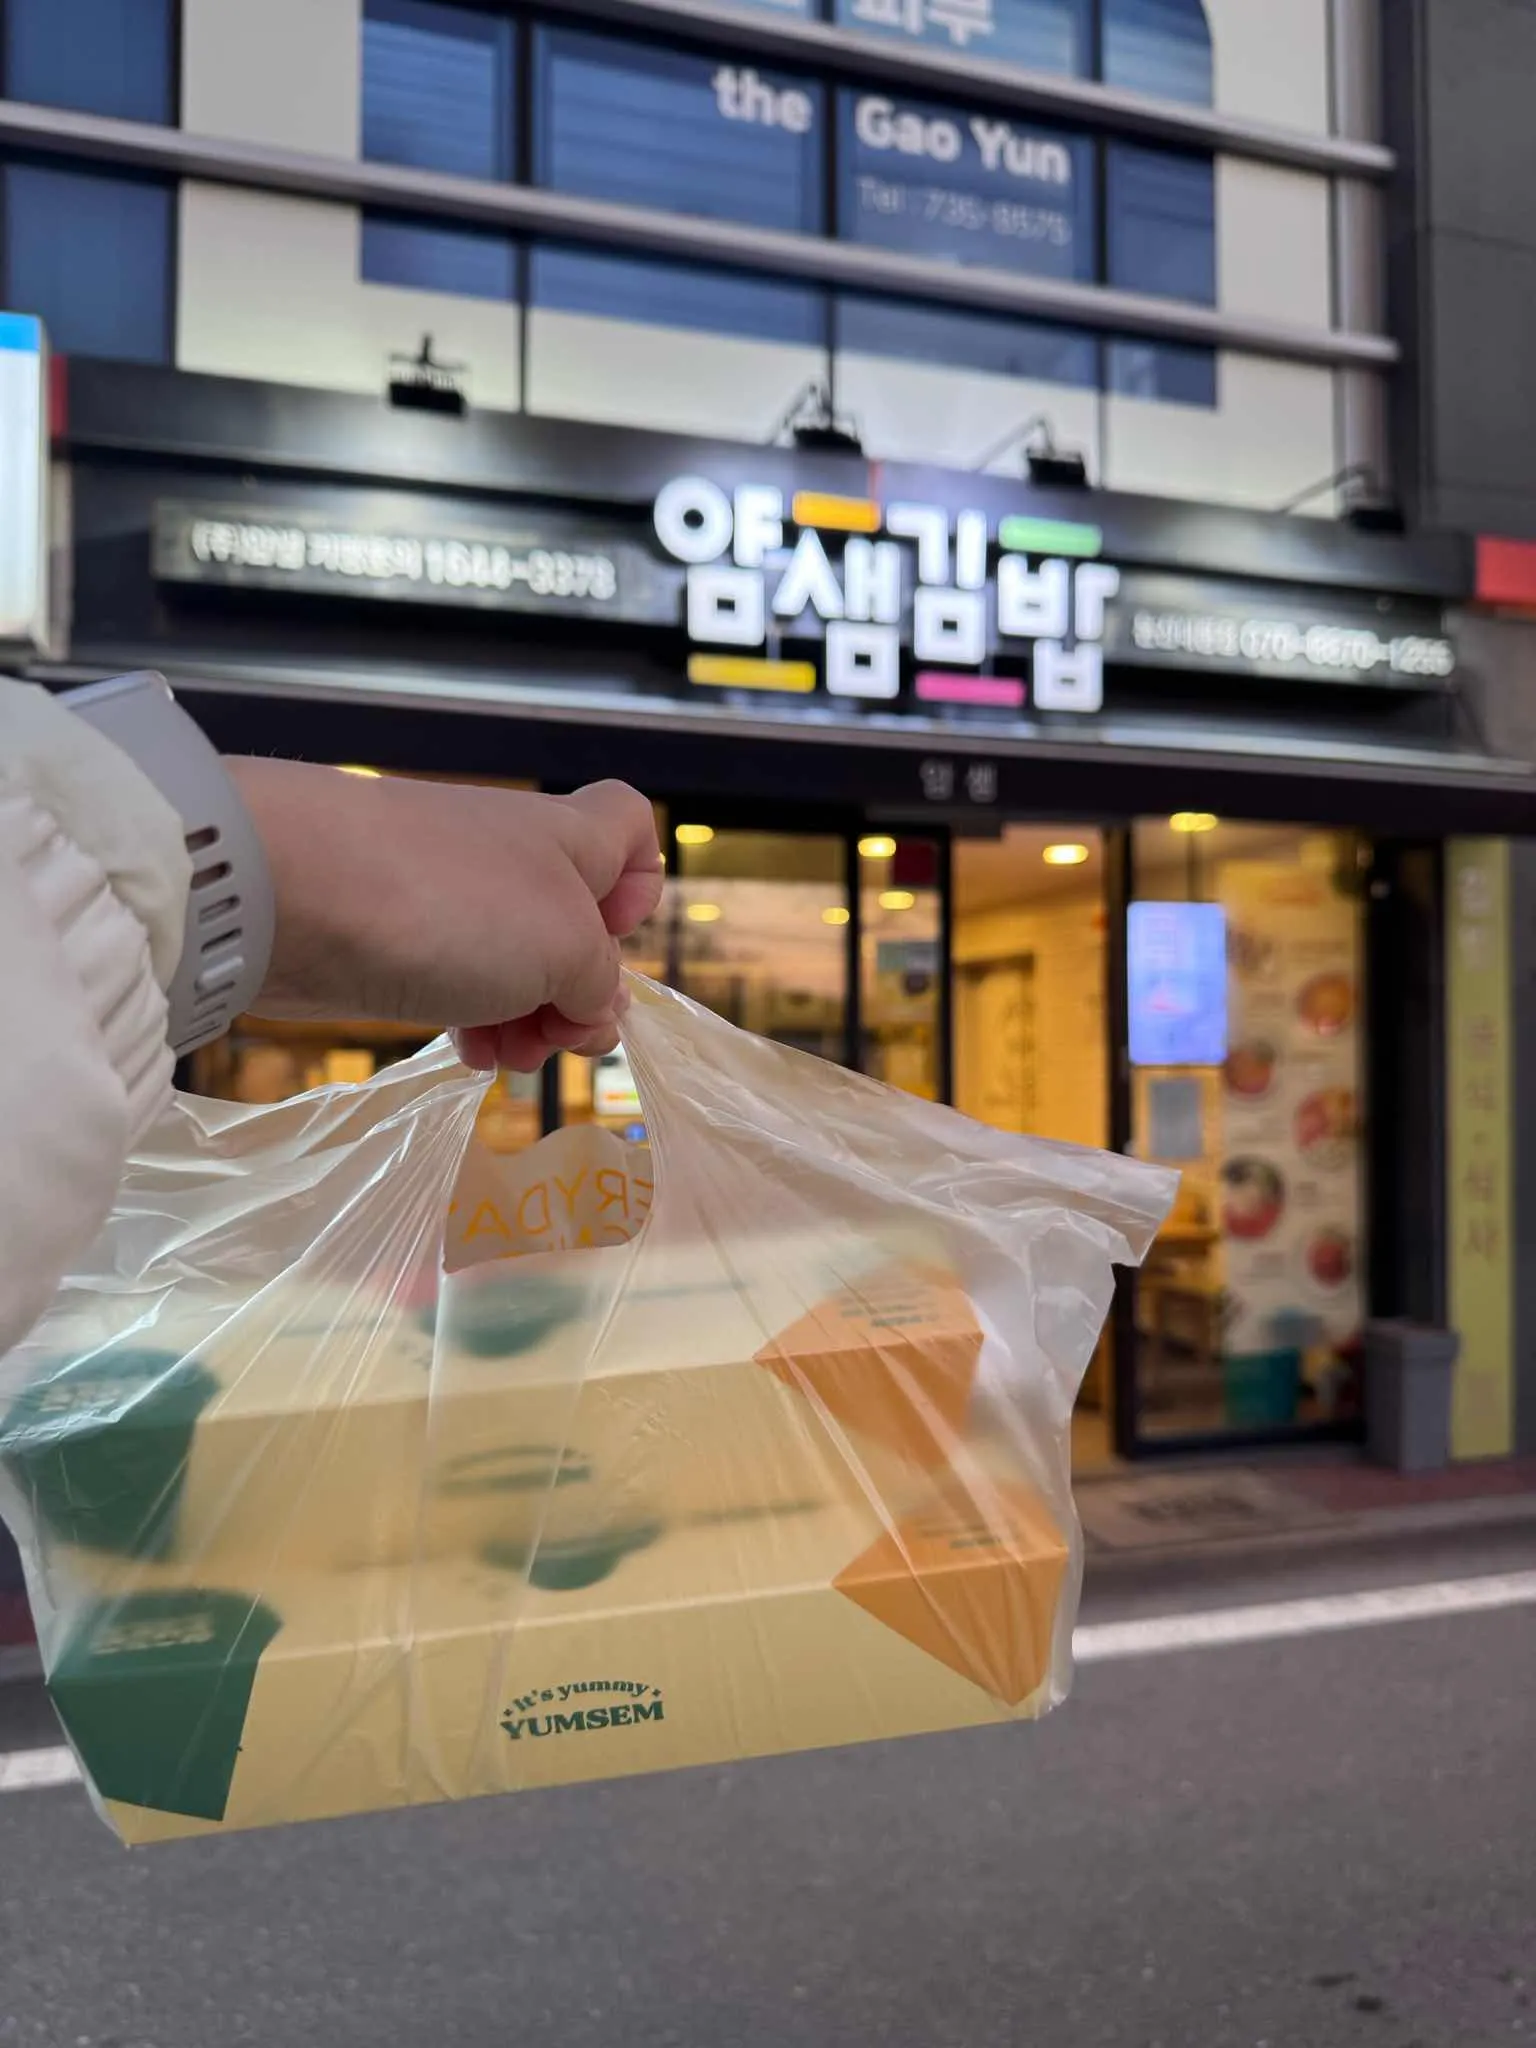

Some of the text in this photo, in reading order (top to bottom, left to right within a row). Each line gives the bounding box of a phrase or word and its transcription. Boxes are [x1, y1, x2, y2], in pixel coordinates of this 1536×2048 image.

[713, 67, 1071, 184] the Gao Yun
[653, 475, 1120, 712] 얌샘김밥
[500, 1700, 665, 1741] YUMSEM
[512, 1680, 650, 1713] It's yummy
